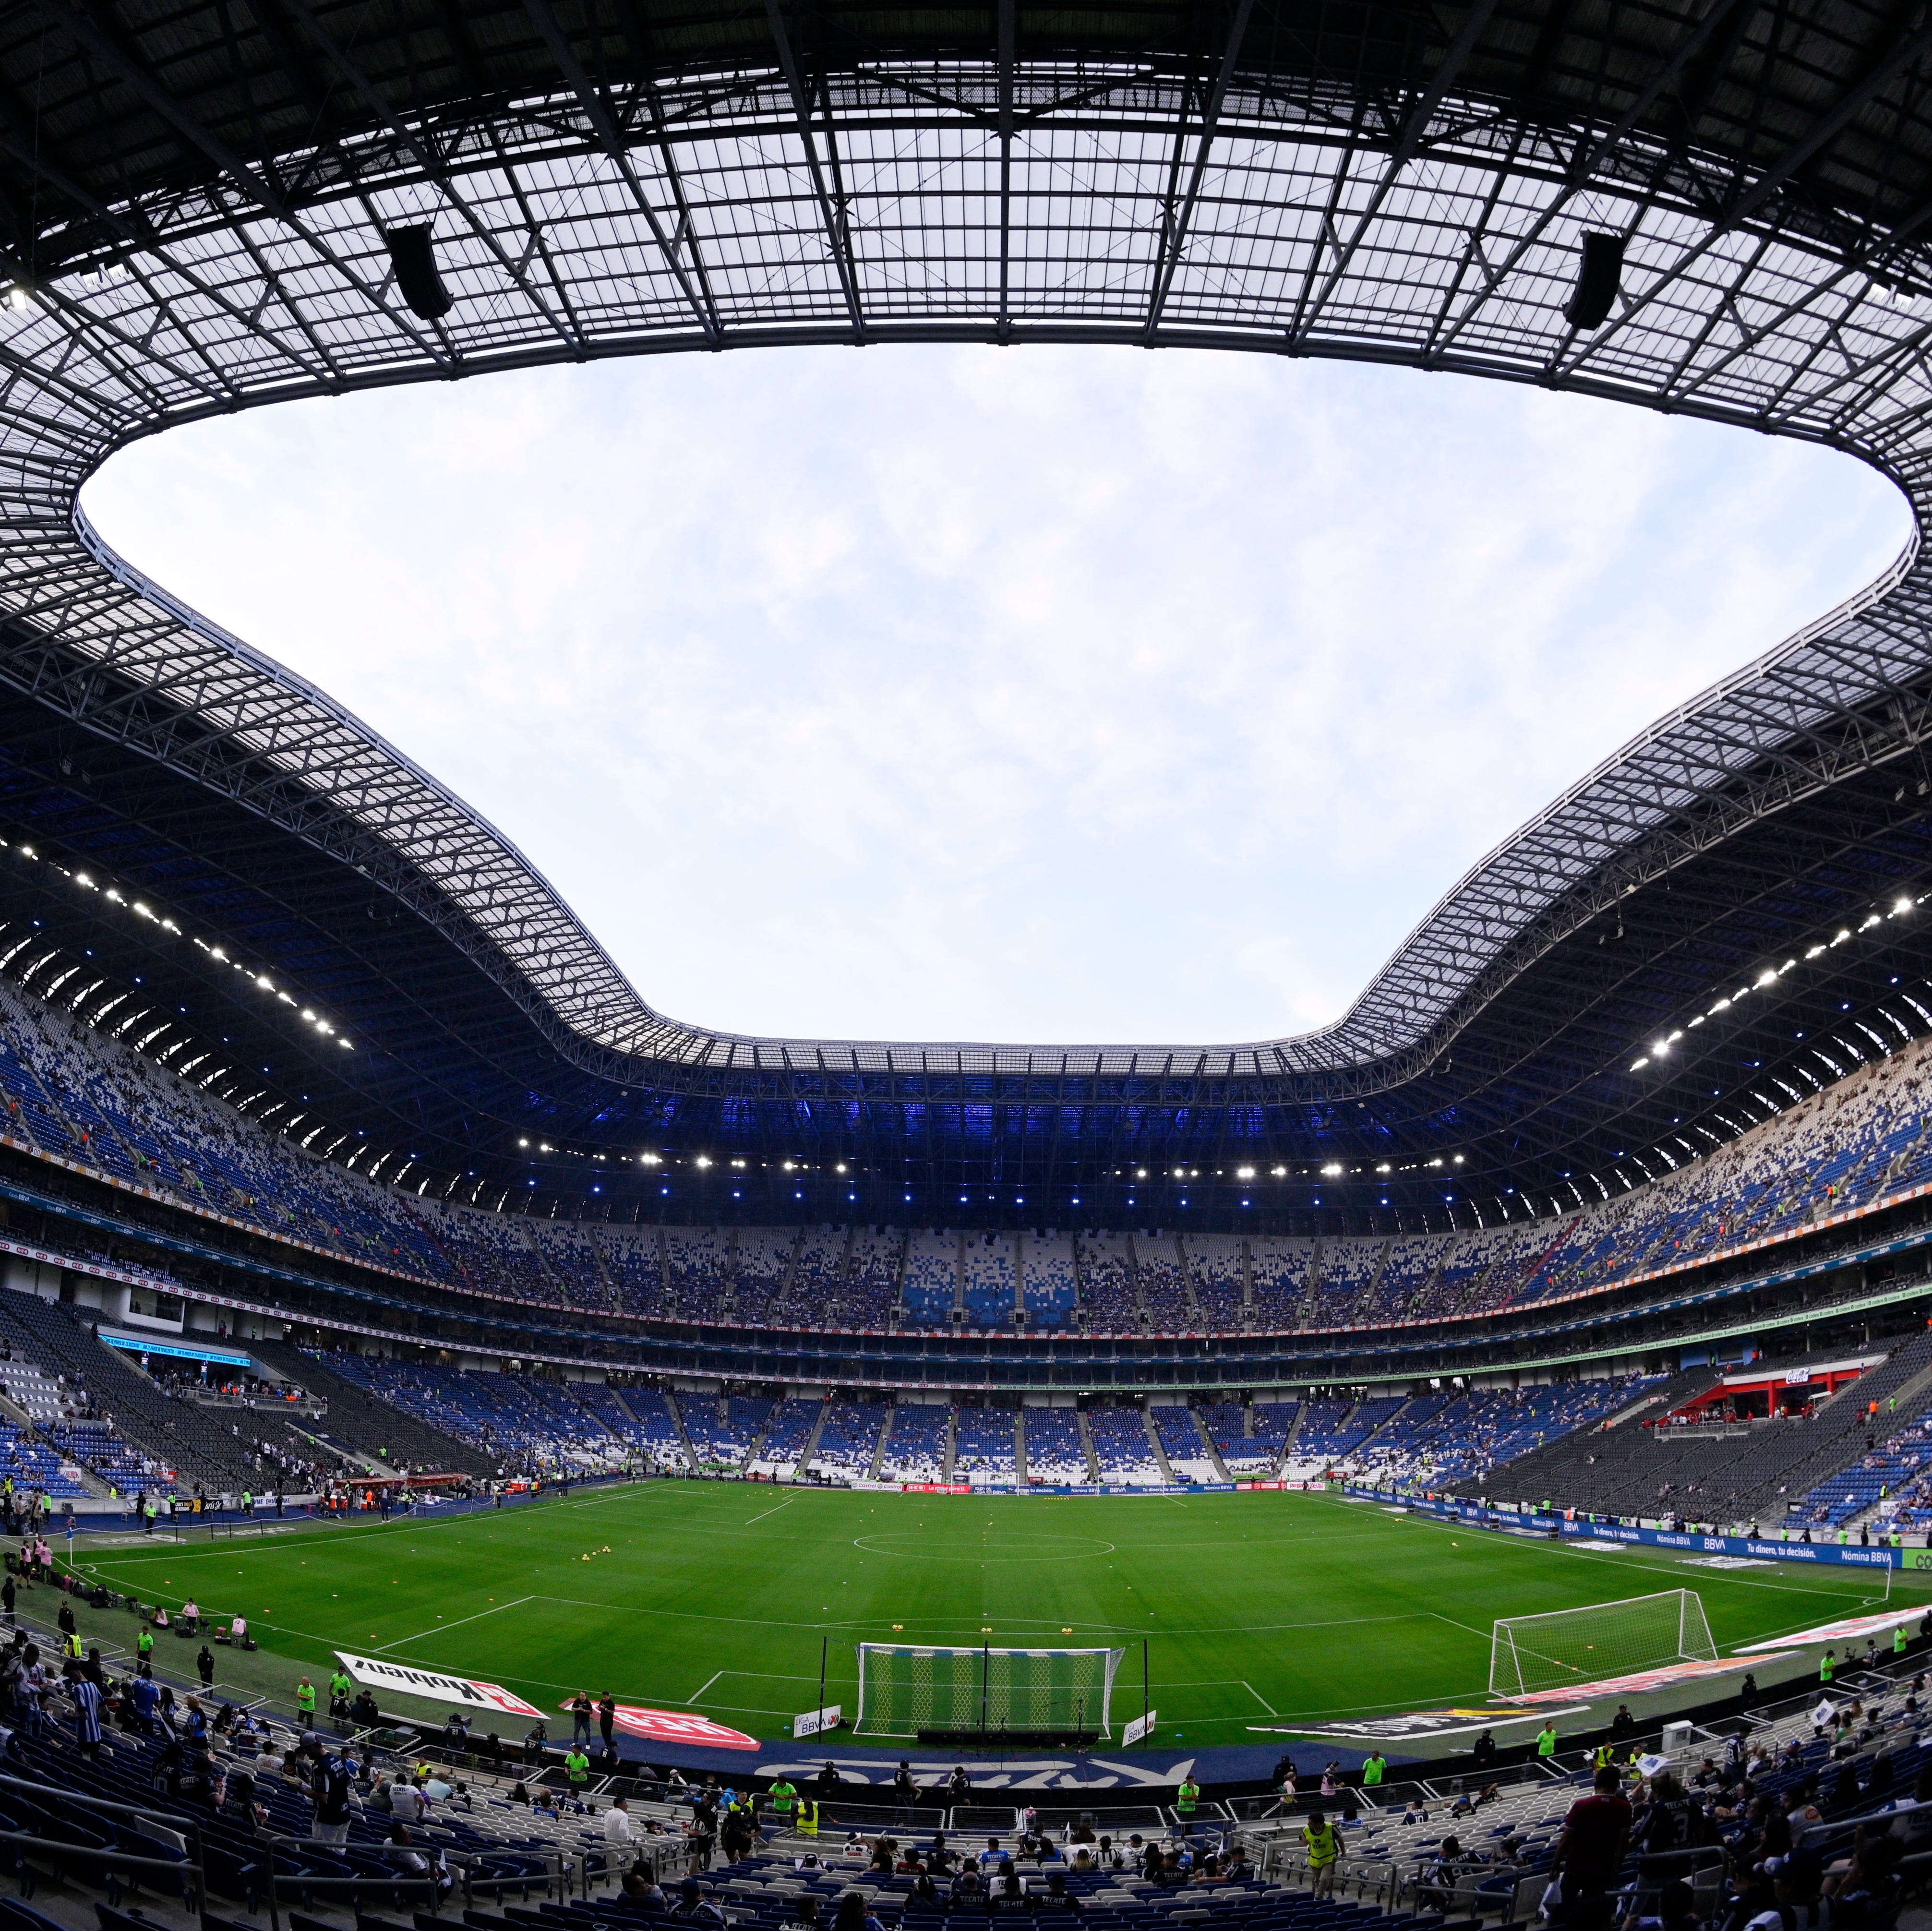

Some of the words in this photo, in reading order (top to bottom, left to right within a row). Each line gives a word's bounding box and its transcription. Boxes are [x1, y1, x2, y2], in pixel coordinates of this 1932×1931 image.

[204, 1501, 215, 1511] arl's
[1467, 1508, 1478, 1516] BBVA
[1564, 1522, 1579, 1532] BBVA
[1599, 1528, 1614, 1537] dinero,
[1620, 1530, 1640, 1540] decisión.
[1657, 1534, 1675, 1544] Nómina
[1676, 1536, 1691, 1546] BBVA
[1704, 1538, 1726, 1550] BBVA
[1747, 1543, 1754, 1553] Tu
[1755, 1544, 1777, 1555] dinero,
[1778, 1546, 1786, 1555] tu
[1787, 1548, 1816, 1558] decisión.
[1842, 1550, 1869, 1561] Nómina
[1871, 1552, 1891, 1562] BBVA
[354, 1659, 485, 1702] Koblenz
[795, 1716, 809, 1725] LIGA
[802, 1718, 826, 1733] BBVA
[564, 1804, 575, 1812] 17
[1665, 1799, 1690, 1810] TECATE
[1458, 1809, 1472, 1817] TECATE
[1415, 1815, 1424, 1823] 10
[1673, 1813, 1689, 1844] 3
[1042, 1895, 1067, 1904] TECATE
[792, 1922, 817, 1931] TECATE
